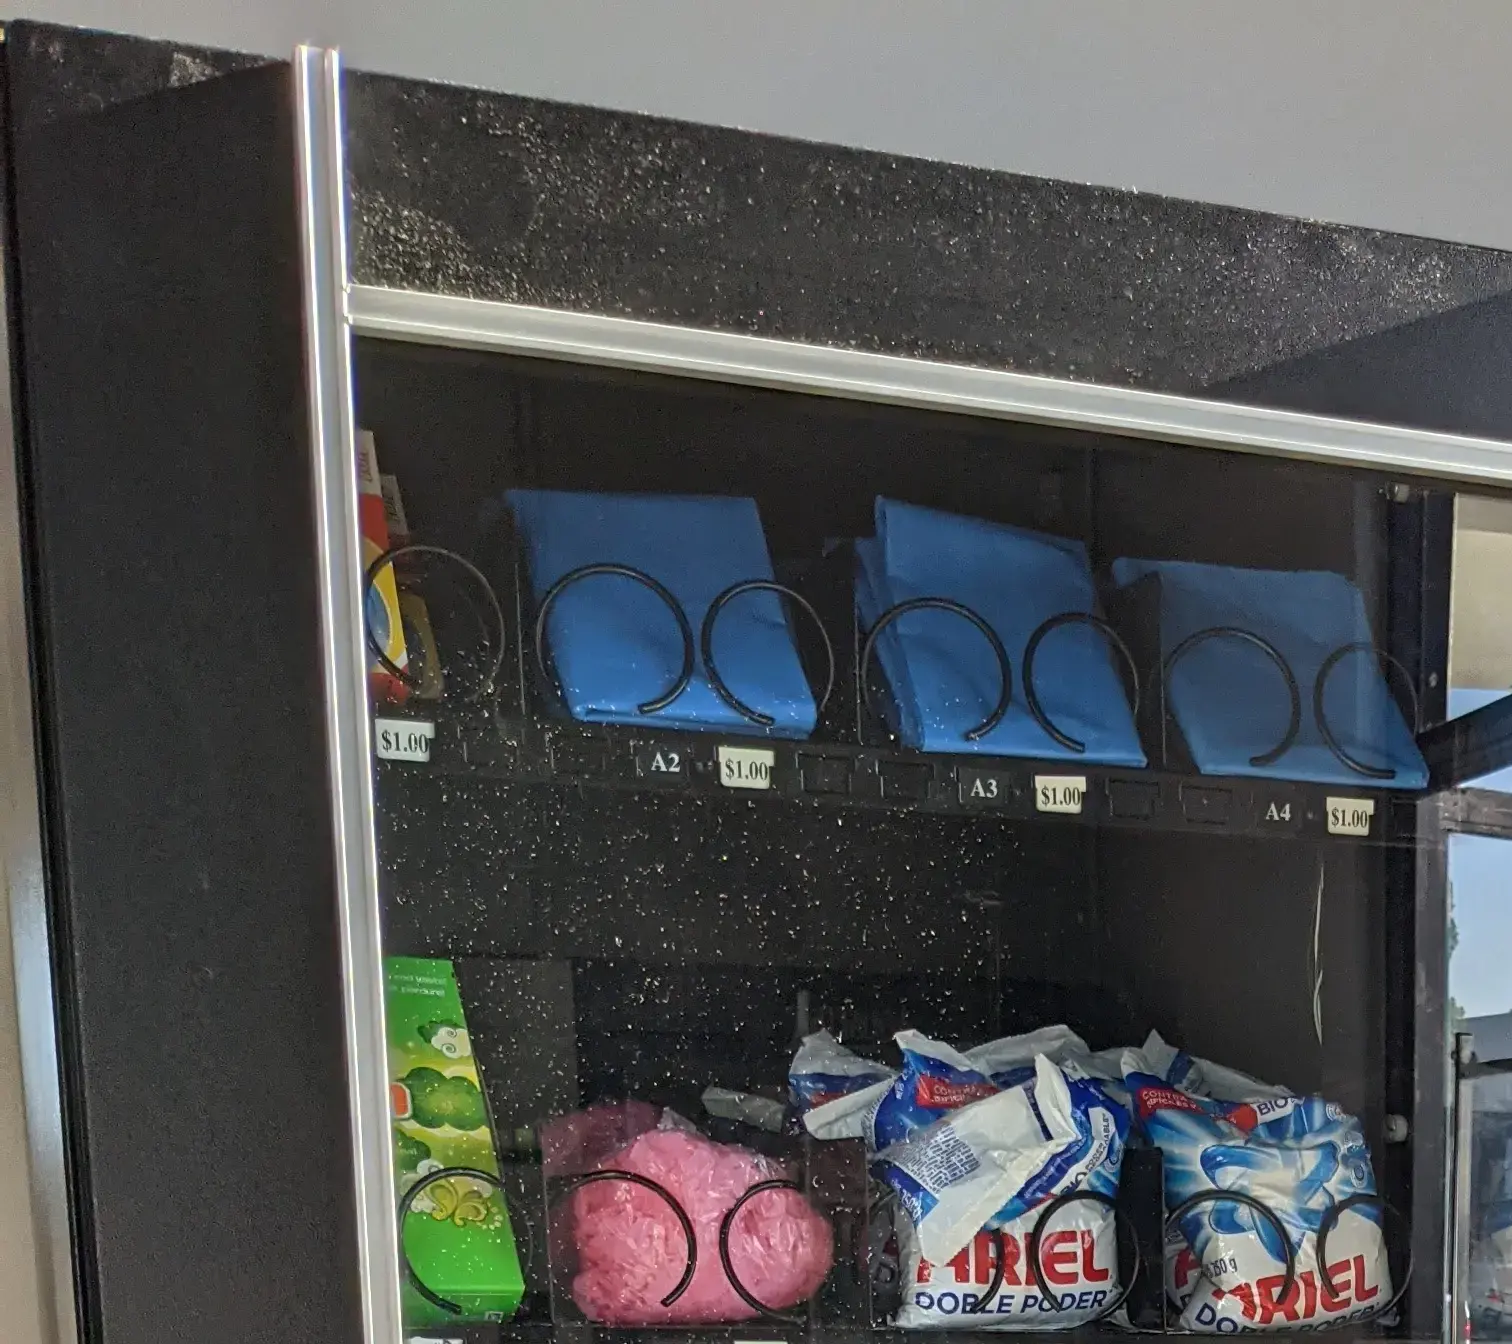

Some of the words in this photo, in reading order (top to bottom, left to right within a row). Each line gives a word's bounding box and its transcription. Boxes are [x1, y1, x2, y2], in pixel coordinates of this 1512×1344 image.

[381, 729, 430, 756] $1.00
[650, 752, 682, 774] A2
[724, 758, 769, 784] $1.00
[969, 779, 999, 799] A3
[1041, 786, 1081, 807] $1.00
[1265, 803, 1292, 822] A4
[1331, 808, 1368, 829] $1.00
[915, 1290, 1013, 1315] DOBLE
